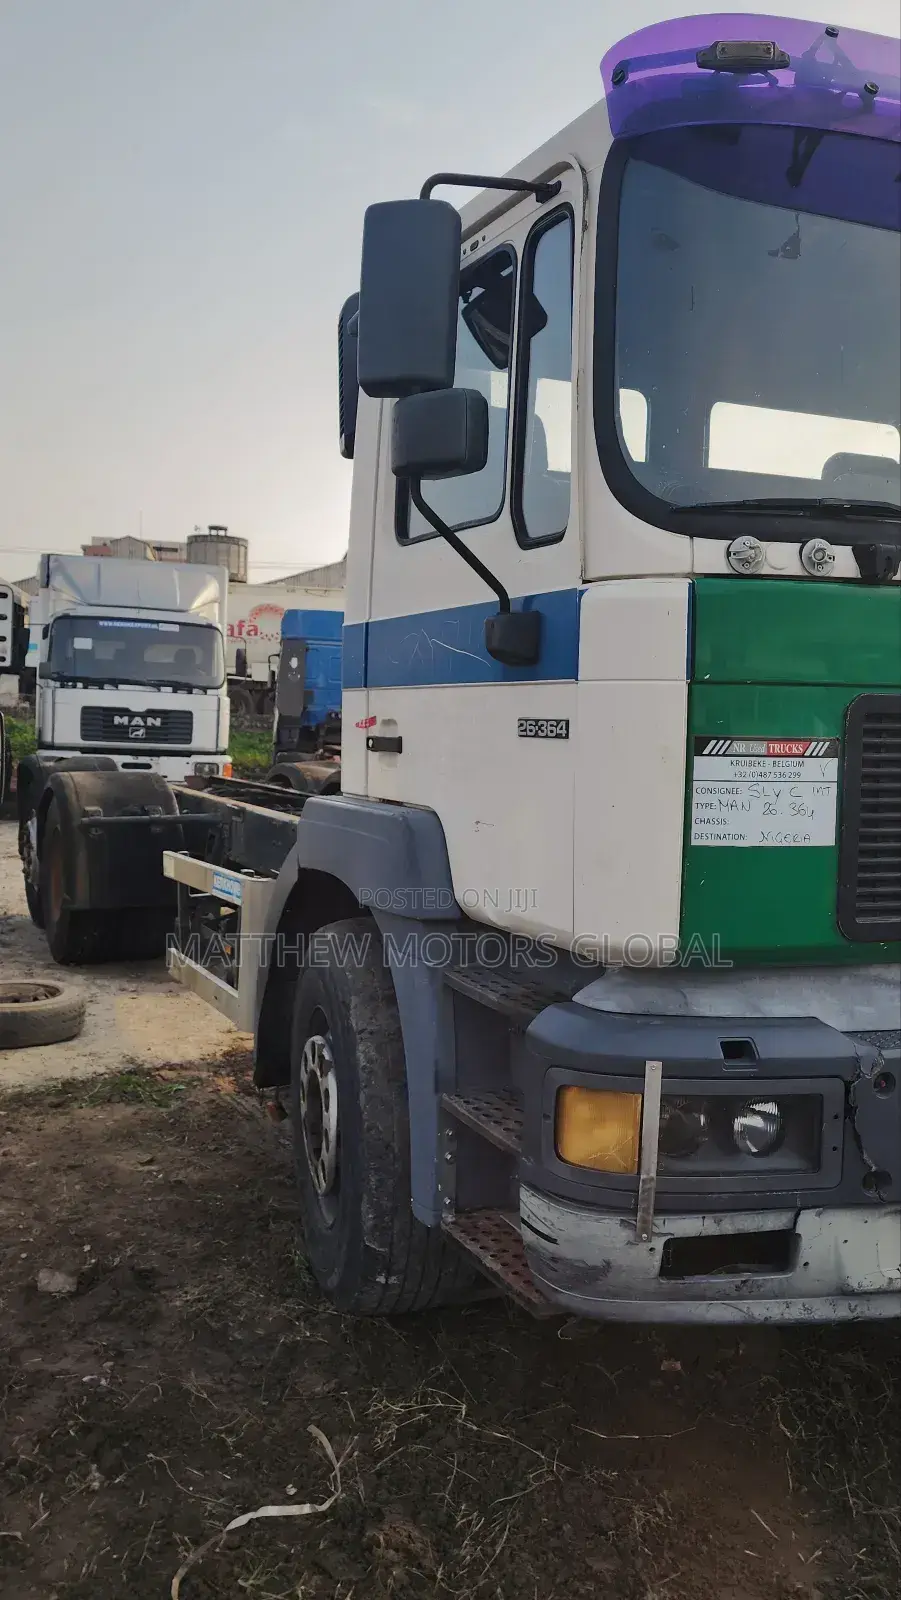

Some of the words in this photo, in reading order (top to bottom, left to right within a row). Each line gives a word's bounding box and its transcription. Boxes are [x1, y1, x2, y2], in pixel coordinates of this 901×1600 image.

[113, 715, 161, 727] MAN
[733, 743, 745, 753] NR
[750, 743, 766, 753] Used
[768, 743, 804, 753] TRUCKS
[772, 760, 805, 768] BELGIUM
[749, 771, 771, 779] (0)487
[718, 798, 751, 812] MAN
[694, 833, 748, 841] DESTINATION:
